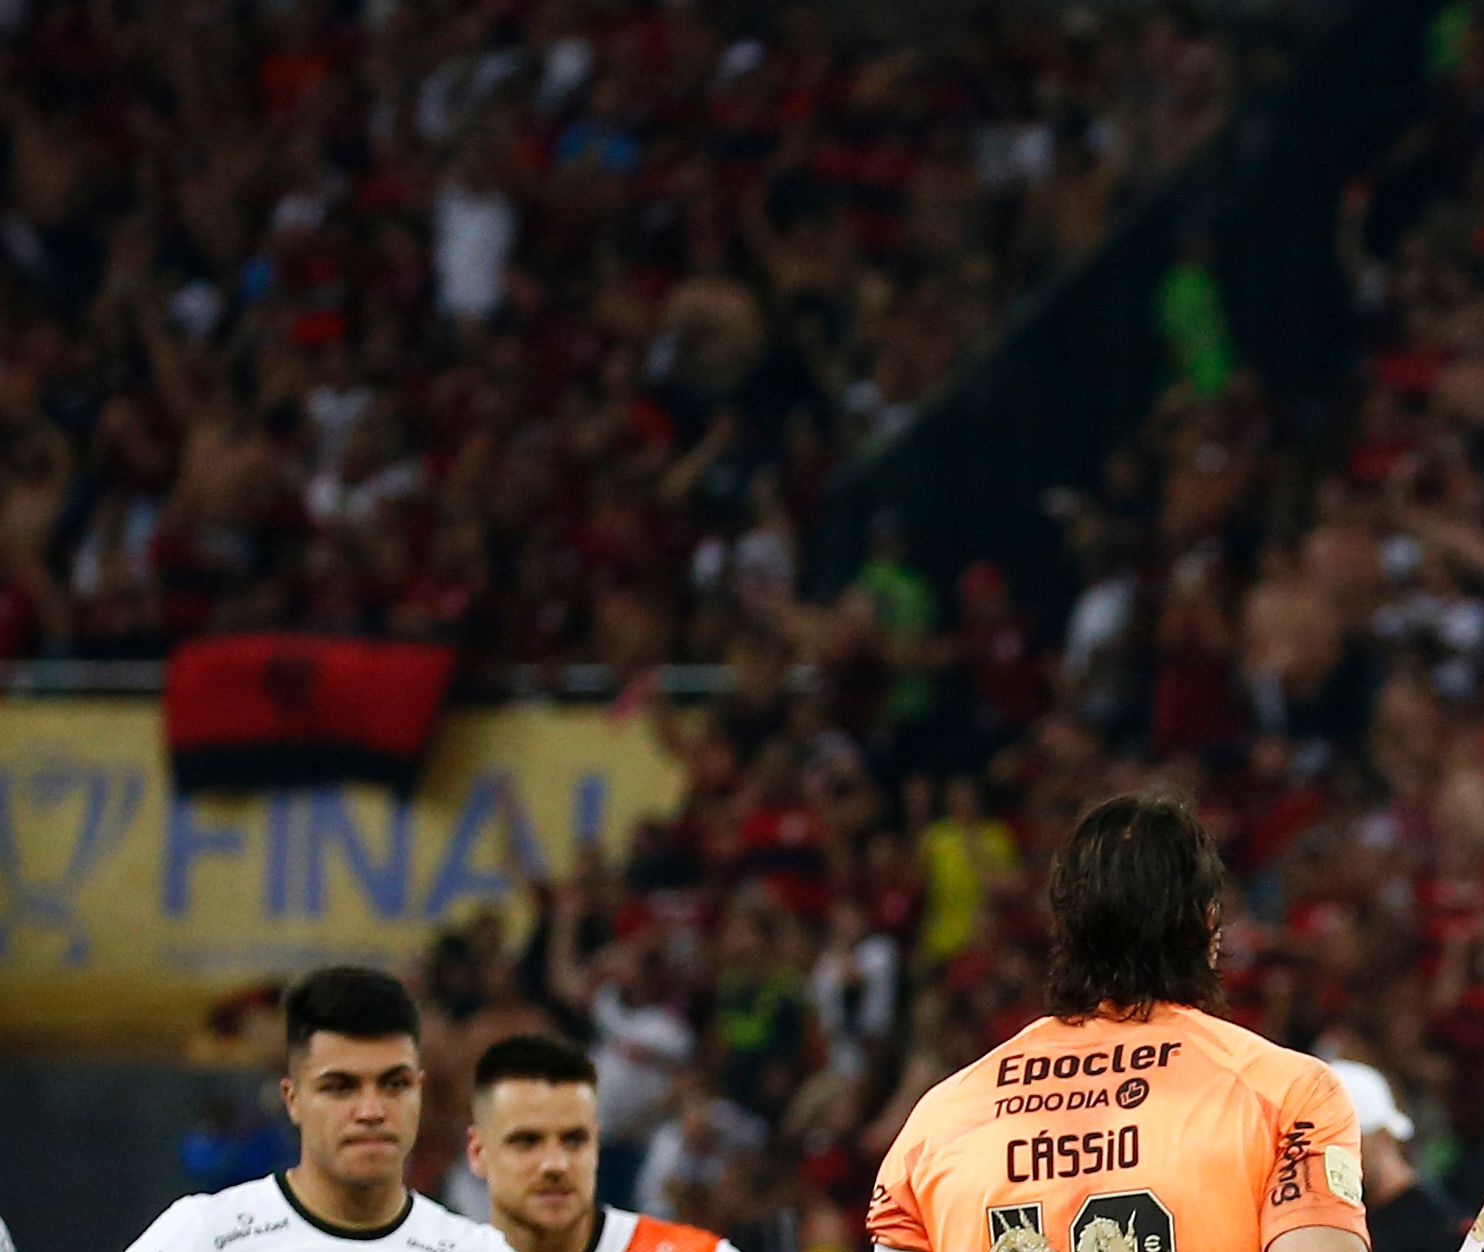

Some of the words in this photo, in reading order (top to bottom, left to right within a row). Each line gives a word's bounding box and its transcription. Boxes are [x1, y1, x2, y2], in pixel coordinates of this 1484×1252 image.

[997, 1041, 1181, 1087] Epocler
[993, 1093, 1063, 1119] TODO
[1066, 1087, 1110, 1110] DIA
